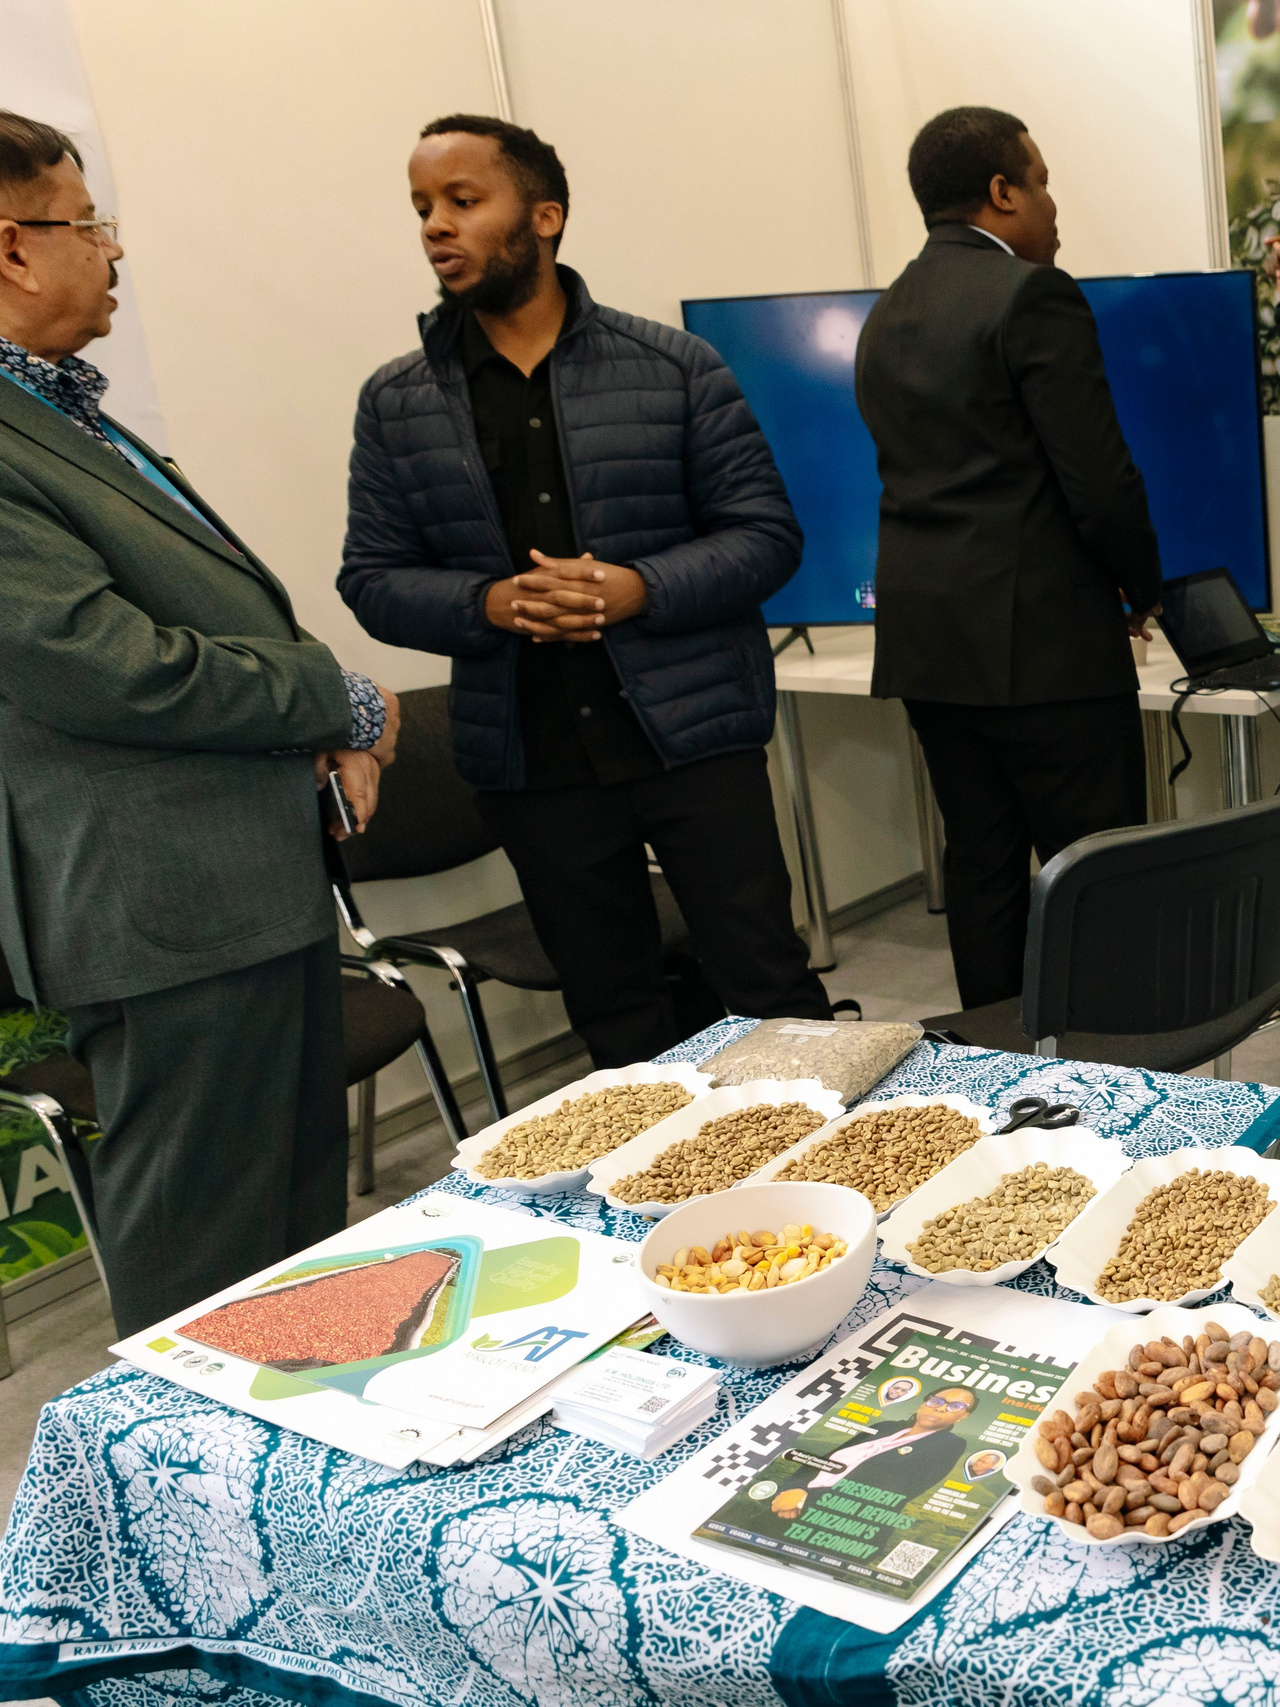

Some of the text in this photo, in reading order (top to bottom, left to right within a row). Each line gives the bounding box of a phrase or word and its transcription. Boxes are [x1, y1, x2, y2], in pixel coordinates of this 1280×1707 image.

[889, 1345, 1058, 1403] Busines
[816, 1492, 916, 1531] SAMIA REVIVES
[831, 1478, 907, 1508] PRESIDENT
[783, 1522, 879, 1560] TEA ECONOMY
[800, 1507, 880, 1541] TANZANIA'S
[708, 1523, 726, 1532] KENYA
[729, 1529, 752, 1540] UGANDA
[755, 1537, 779, 1548] MALAWI
[781, 1545, 809, 1557] TANZANIA
[820, 1556, 842, 1567] ZAMBIA
[847, 1564, 873, 1576] RWANDA
[74, 1643, 122, 1656] RAFIKI
